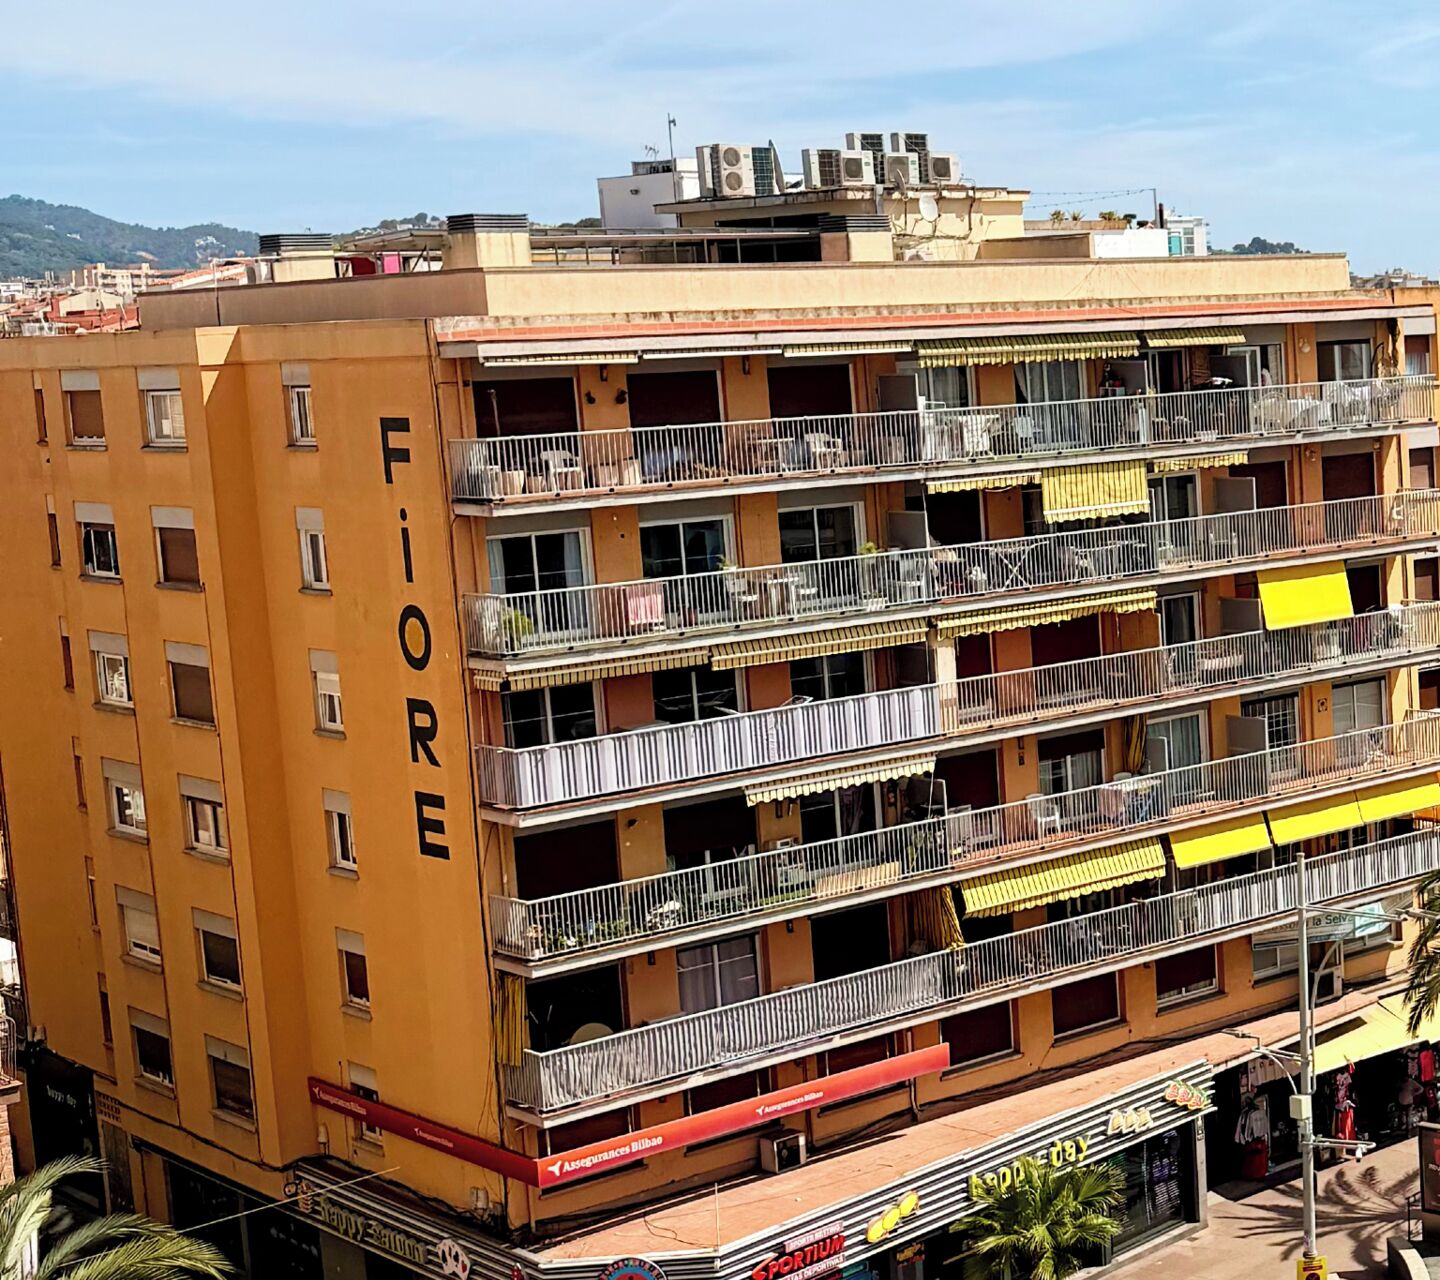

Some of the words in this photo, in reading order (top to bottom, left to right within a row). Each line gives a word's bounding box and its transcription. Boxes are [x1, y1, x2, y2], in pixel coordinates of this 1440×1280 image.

[1312, 915, 1322, 927] la
[562, 1144, 631, 1174] Assegurances
[631, 1135, 664, 1153] Bilbao
[1050, 1134, 1091, 1168] day
[803, 1255, 844, 1279] DEPORTIVAS
